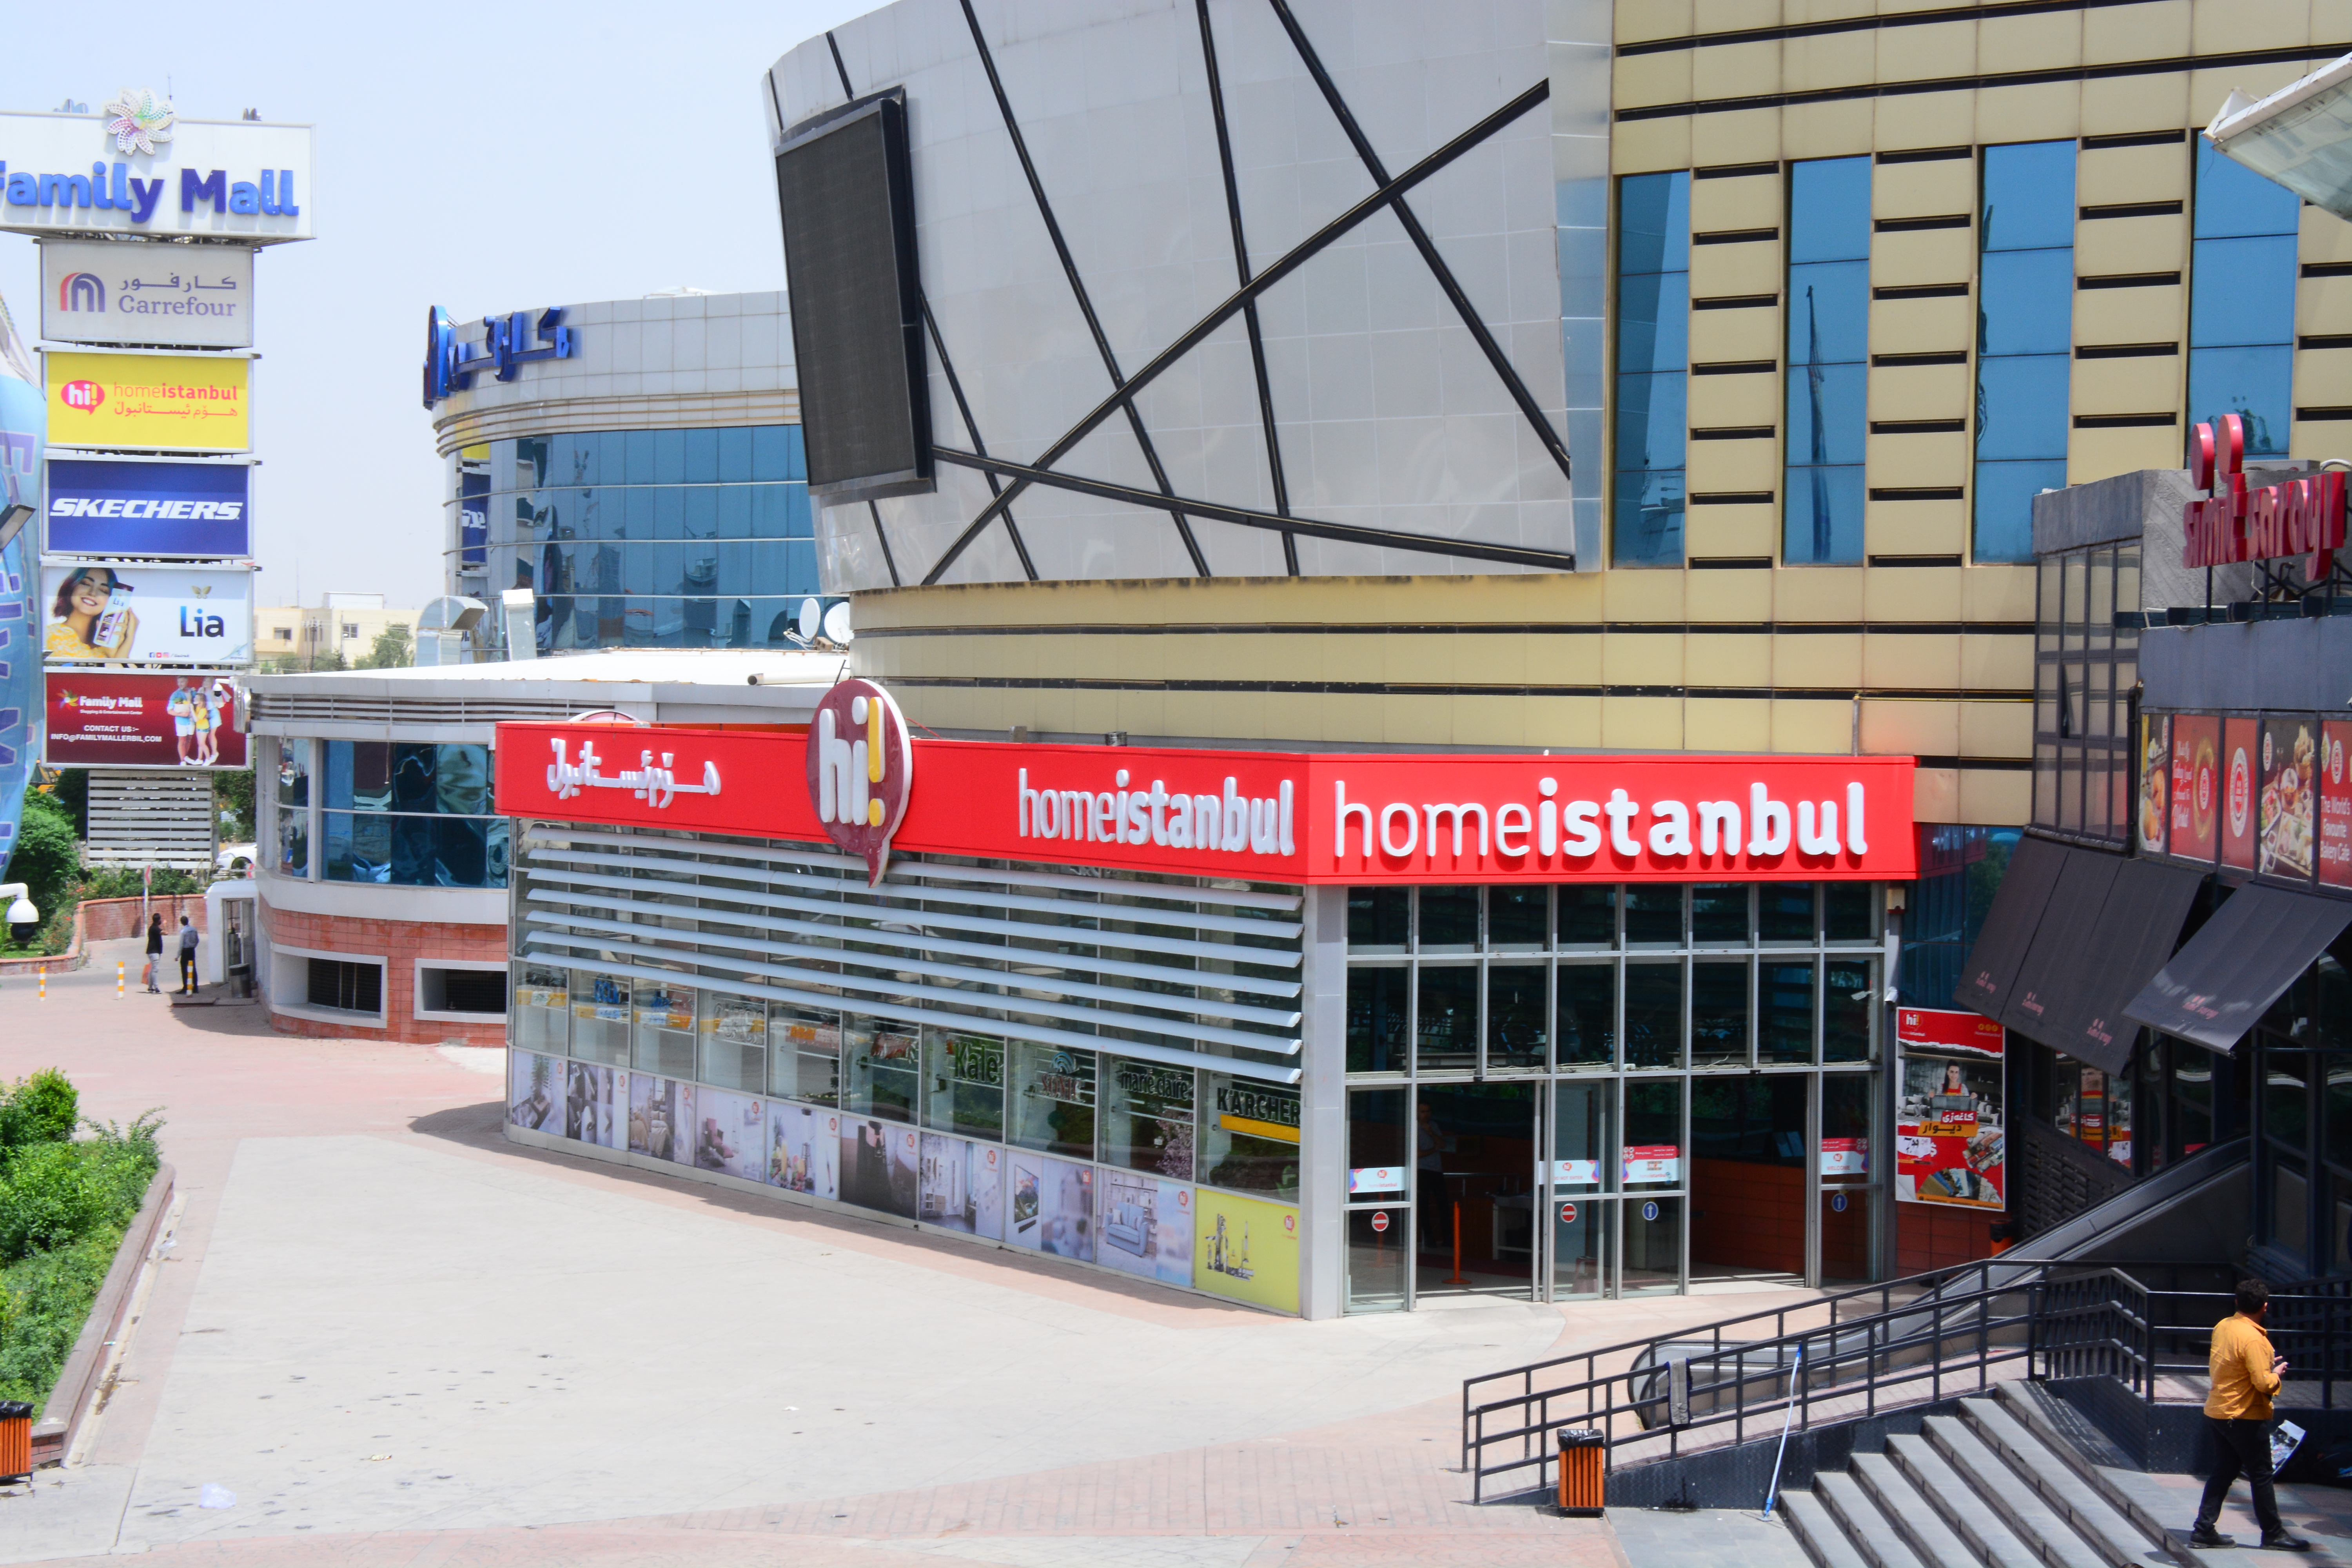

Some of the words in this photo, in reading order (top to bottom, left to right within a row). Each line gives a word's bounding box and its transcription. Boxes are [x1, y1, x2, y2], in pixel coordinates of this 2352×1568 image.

[0, 161, 164, 223] amily
[181, 169, 299, 216] Mall
[118, 295, 236, 316] Carrefour
[68, 383, 98, 406] hi!
[114, 382, 238, 401] homeistanbul
[49, 497, 243, 520] SKECHERS
[180, 606, 224, 637] Lia
[80, 696, 117, 709] Family
[118, 697, 143, 708] Mall
[818, 695, 887, 827] hi!
[1018, 768, 1296, 857] homeistanbul
[1335, 777, 1868, 858] homeistanbul
[1906, 1014, 1920, 1026] hi!
[953, 1041, 999, 1084] Kale
[1121, 1069, 1155, 1094] marie
[1157, 1072, 1189, 1101] claire
